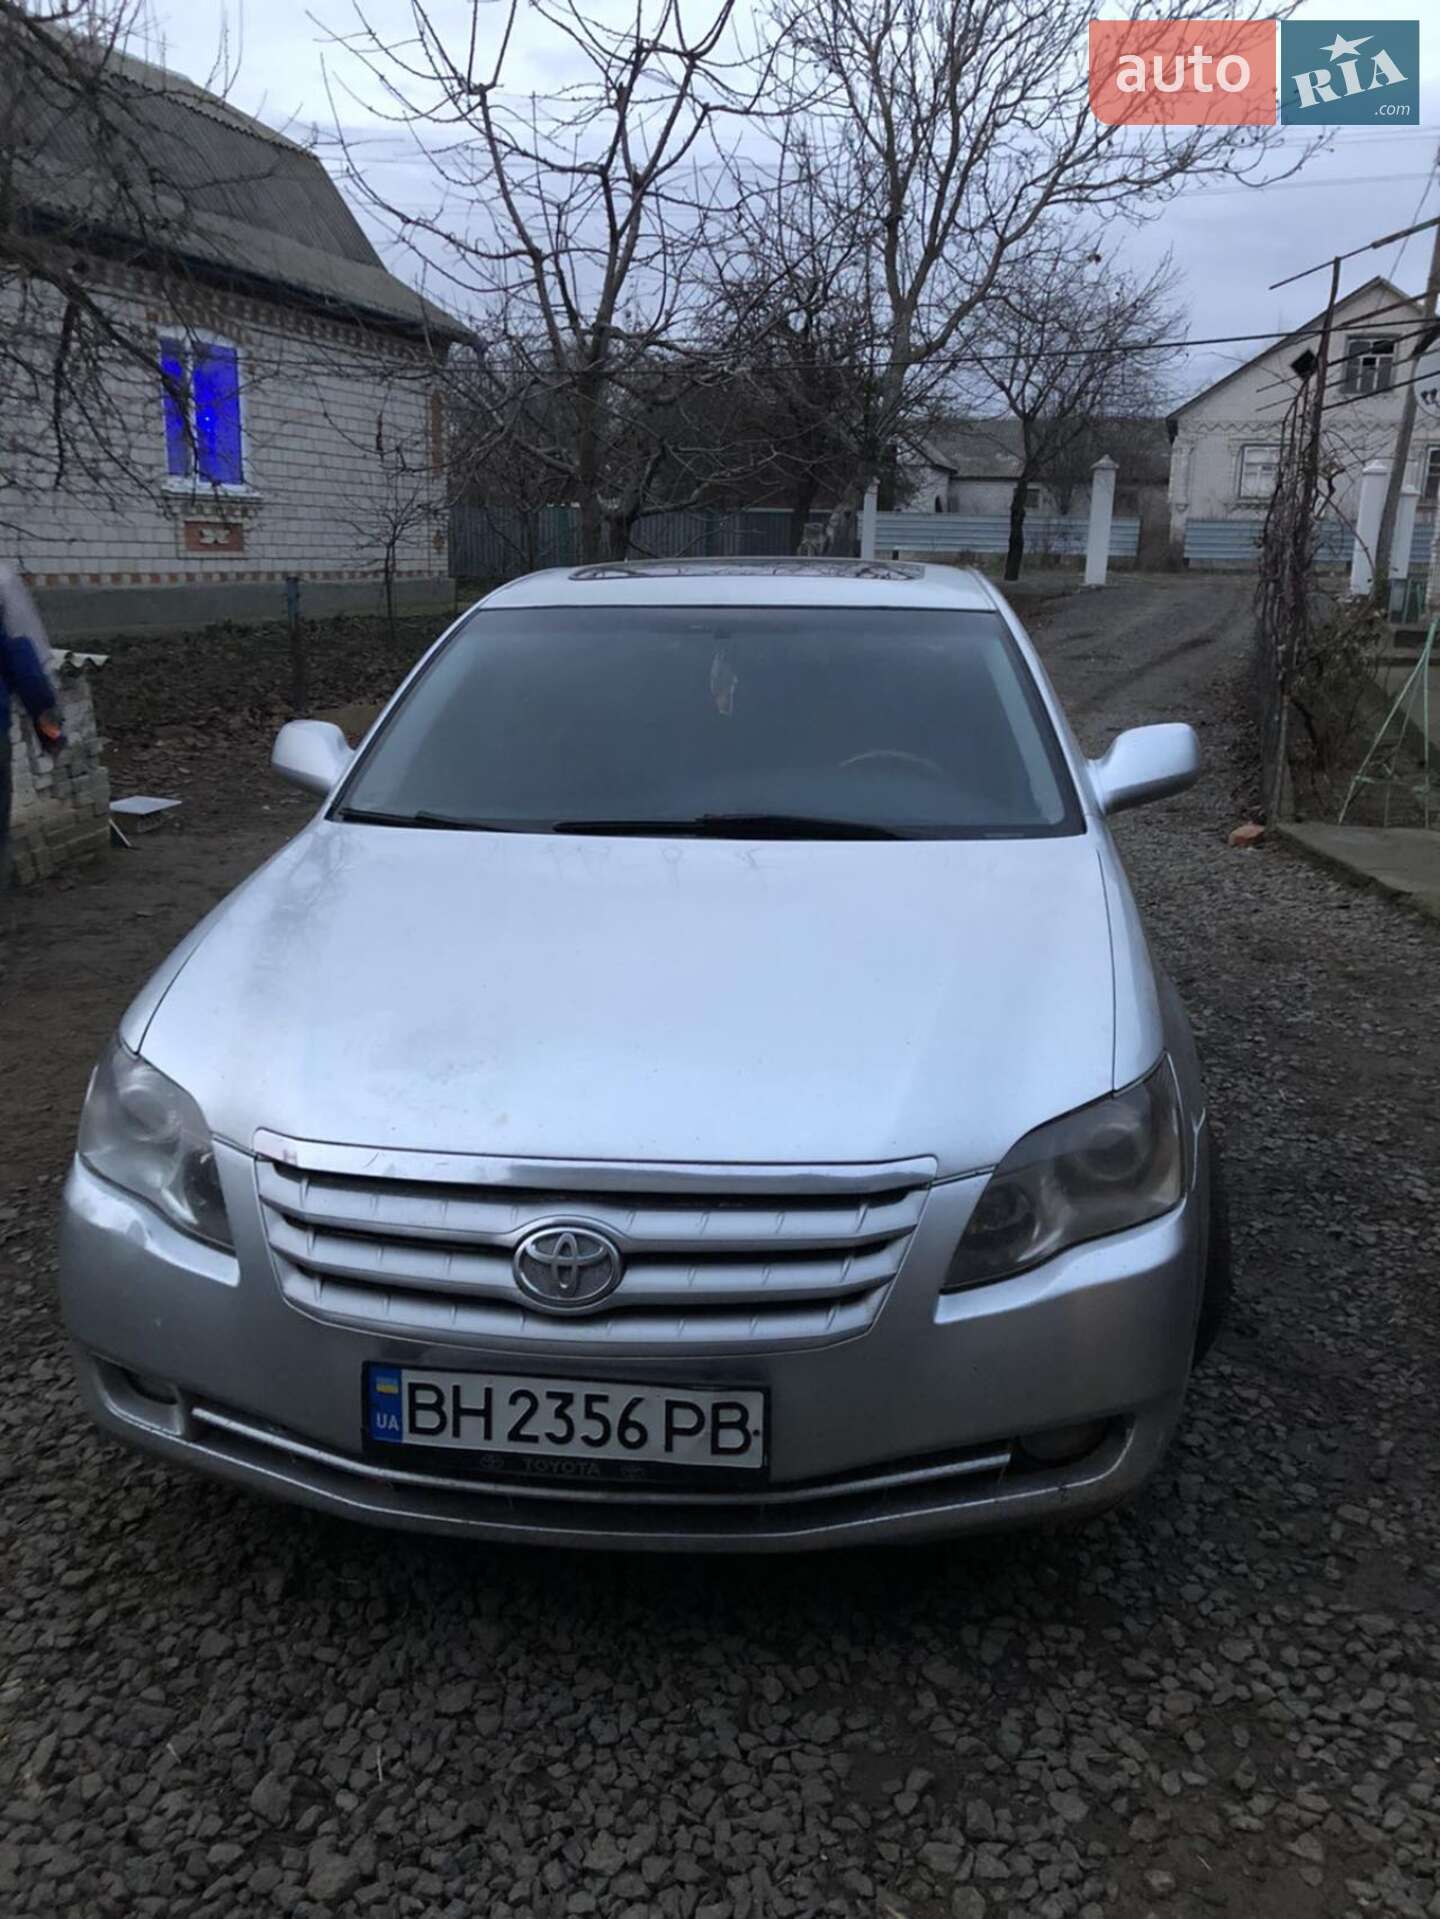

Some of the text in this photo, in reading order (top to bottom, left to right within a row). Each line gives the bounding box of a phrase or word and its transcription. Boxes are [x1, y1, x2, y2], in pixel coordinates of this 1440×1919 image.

[376, 1413, 401, 1432] UA
[407, 1381, 752, 1456] BH 2356 PB
[522, 1457, 601, 1476] TOYOTA
